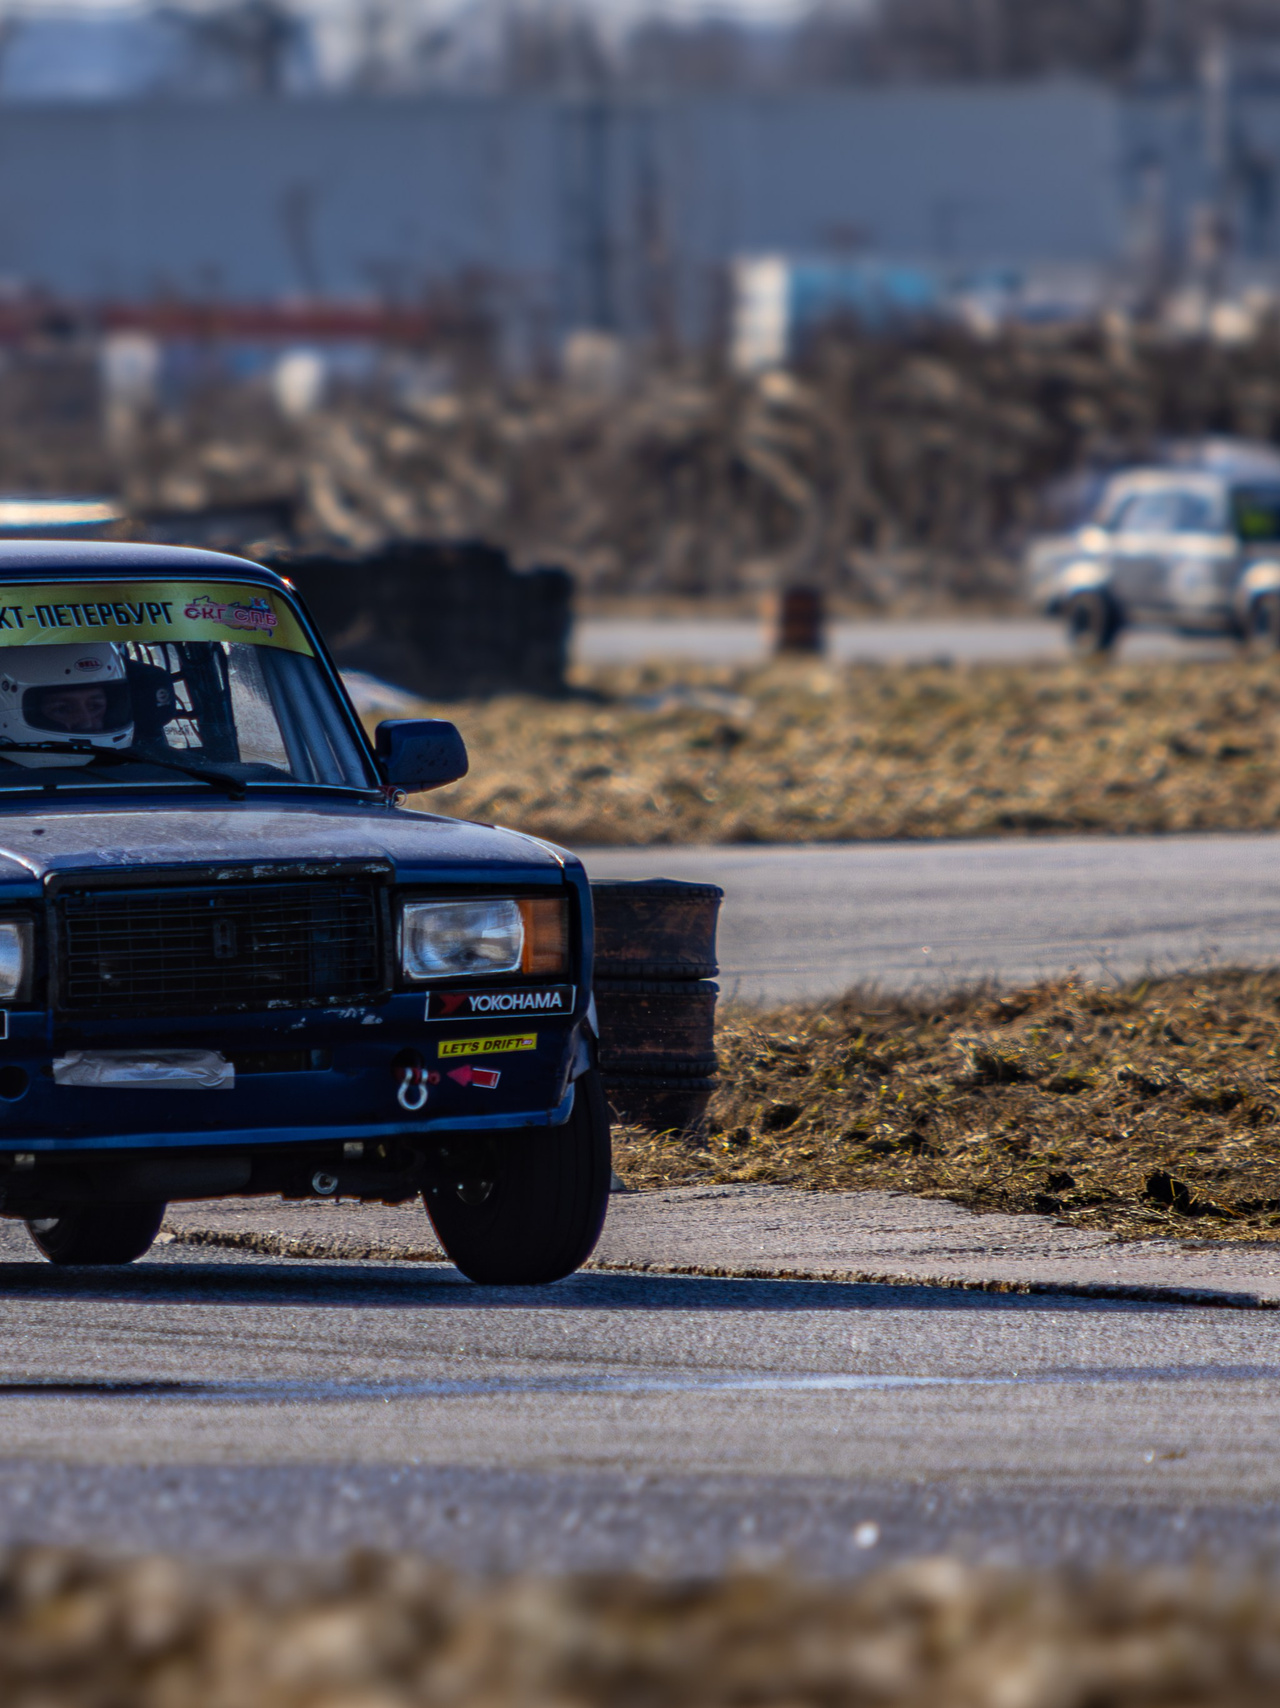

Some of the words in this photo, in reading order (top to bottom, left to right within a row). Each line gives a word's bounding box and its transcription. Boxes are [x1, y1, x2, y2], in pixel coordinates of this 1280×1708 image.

[184, 606, 226, 620] СКГ
[233, 609, 278, 626] СПБ
[469, 992, 562, 1012] YOKOHAMA
[442, 1041, 480, 1055] LET'S
[483, 1038, 524, 1052] DRIFT
